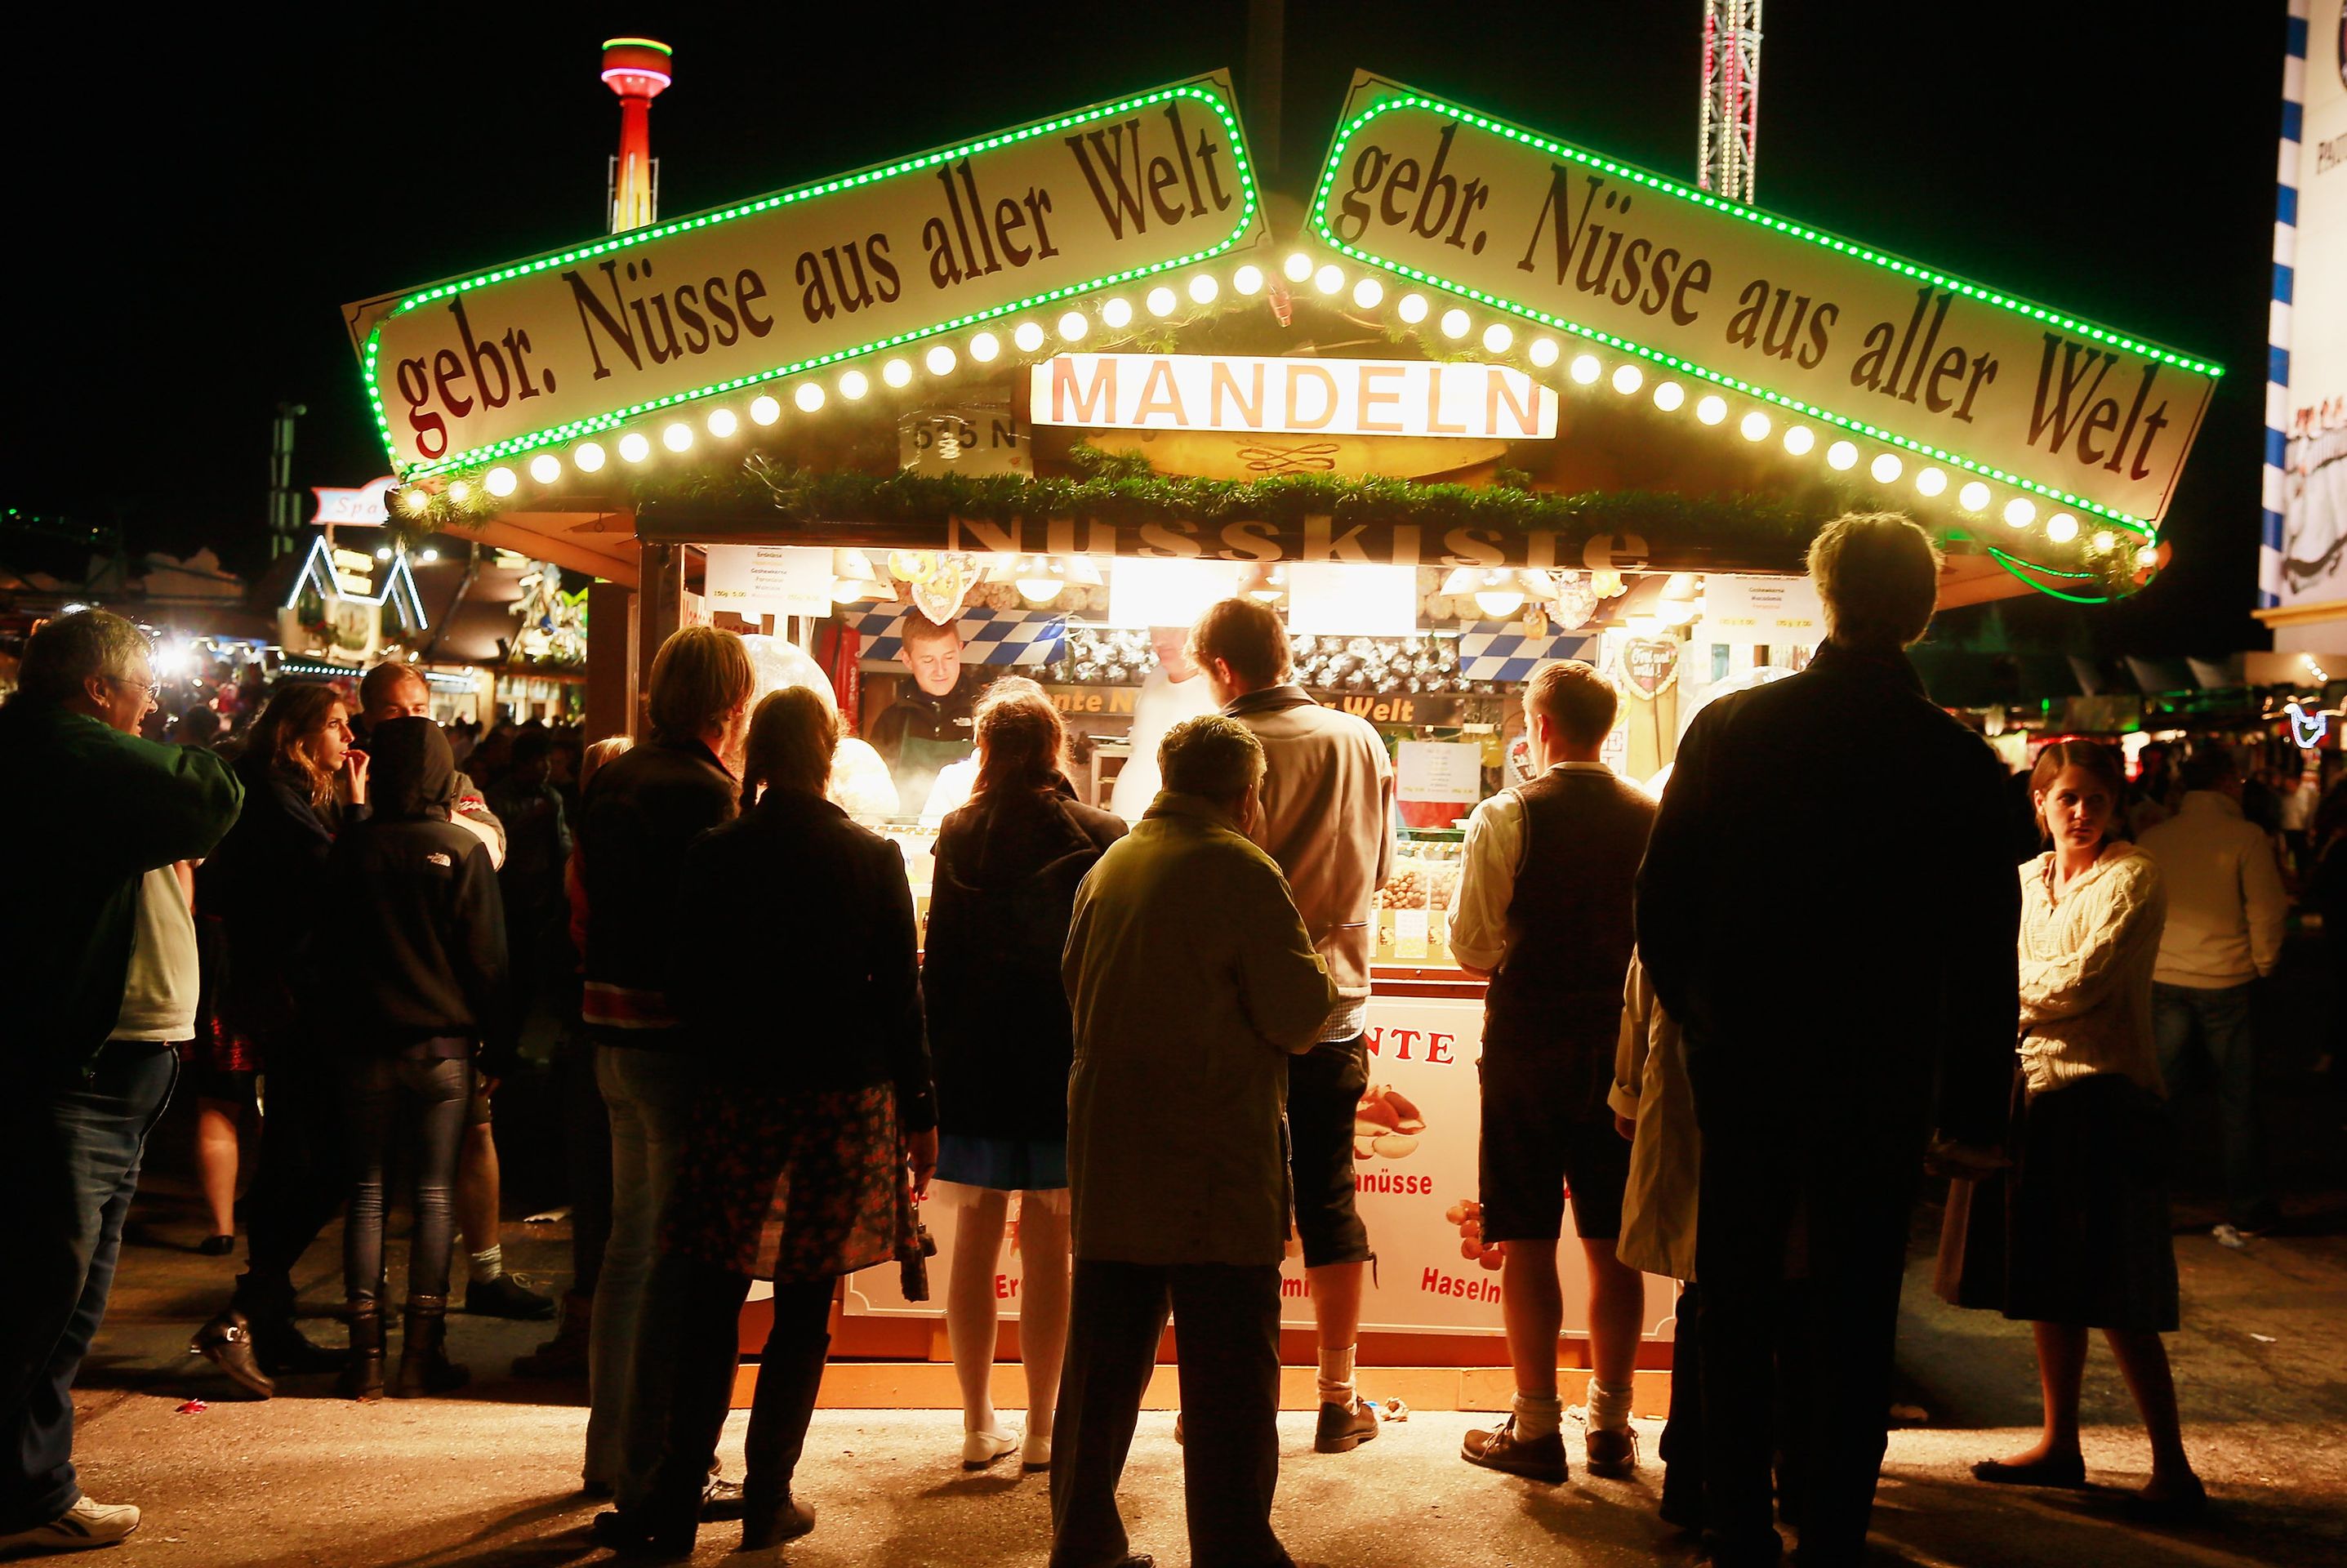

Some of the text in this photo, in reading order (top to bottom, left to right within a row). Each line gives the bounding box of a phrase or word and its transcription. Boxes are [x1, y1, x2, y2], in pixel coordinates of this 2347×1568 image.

[397, 101, 1233, 459] gebr. Nüsse aus aller Welt
[1333, 120, 2171, 482] gebr. Nüsse aus aller Welt
[1052, 358, 1540, 435] MANDELN
[1046, 690, 1102, 712] nte
[1343, 696, 1414, 722] Welt
[1421, 1267, 1502, 1304] Haseln
